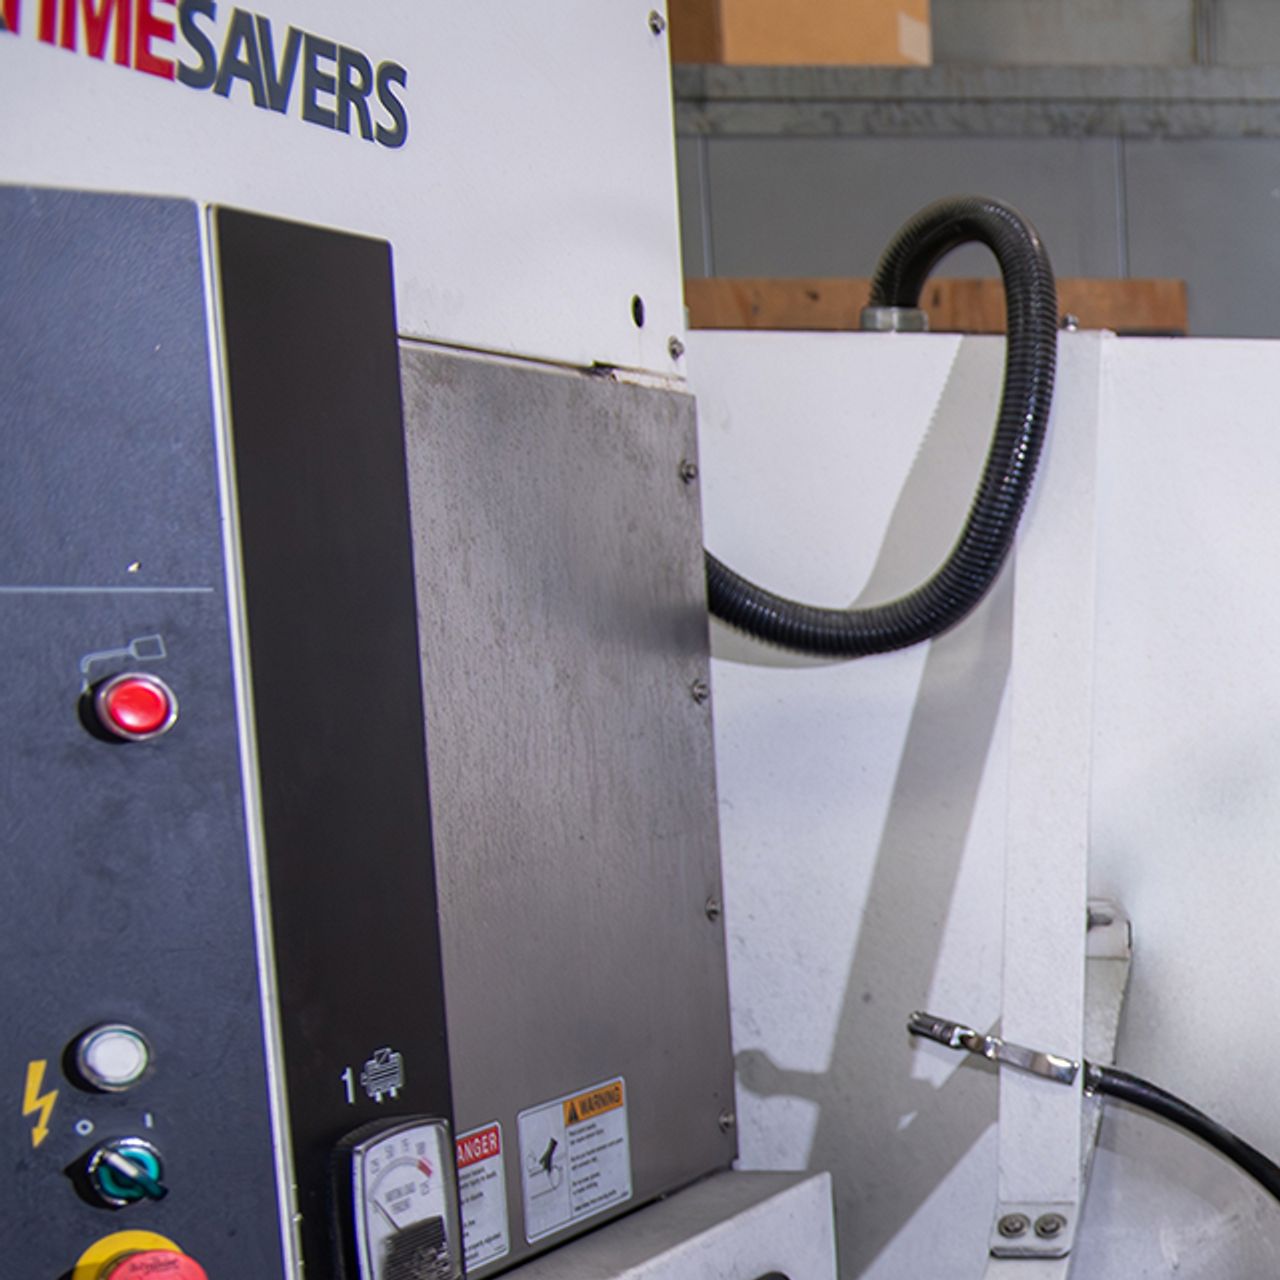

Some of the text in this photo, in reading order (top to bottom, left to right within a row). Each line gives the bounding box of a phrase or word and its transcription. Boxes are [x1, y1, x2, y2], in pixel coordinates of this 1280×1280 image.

[0, 0, 408, 149] MESAVERS
[579, 1085, 621, 1118] WARNING
[456, 1131, 498, 1161] ANGER
